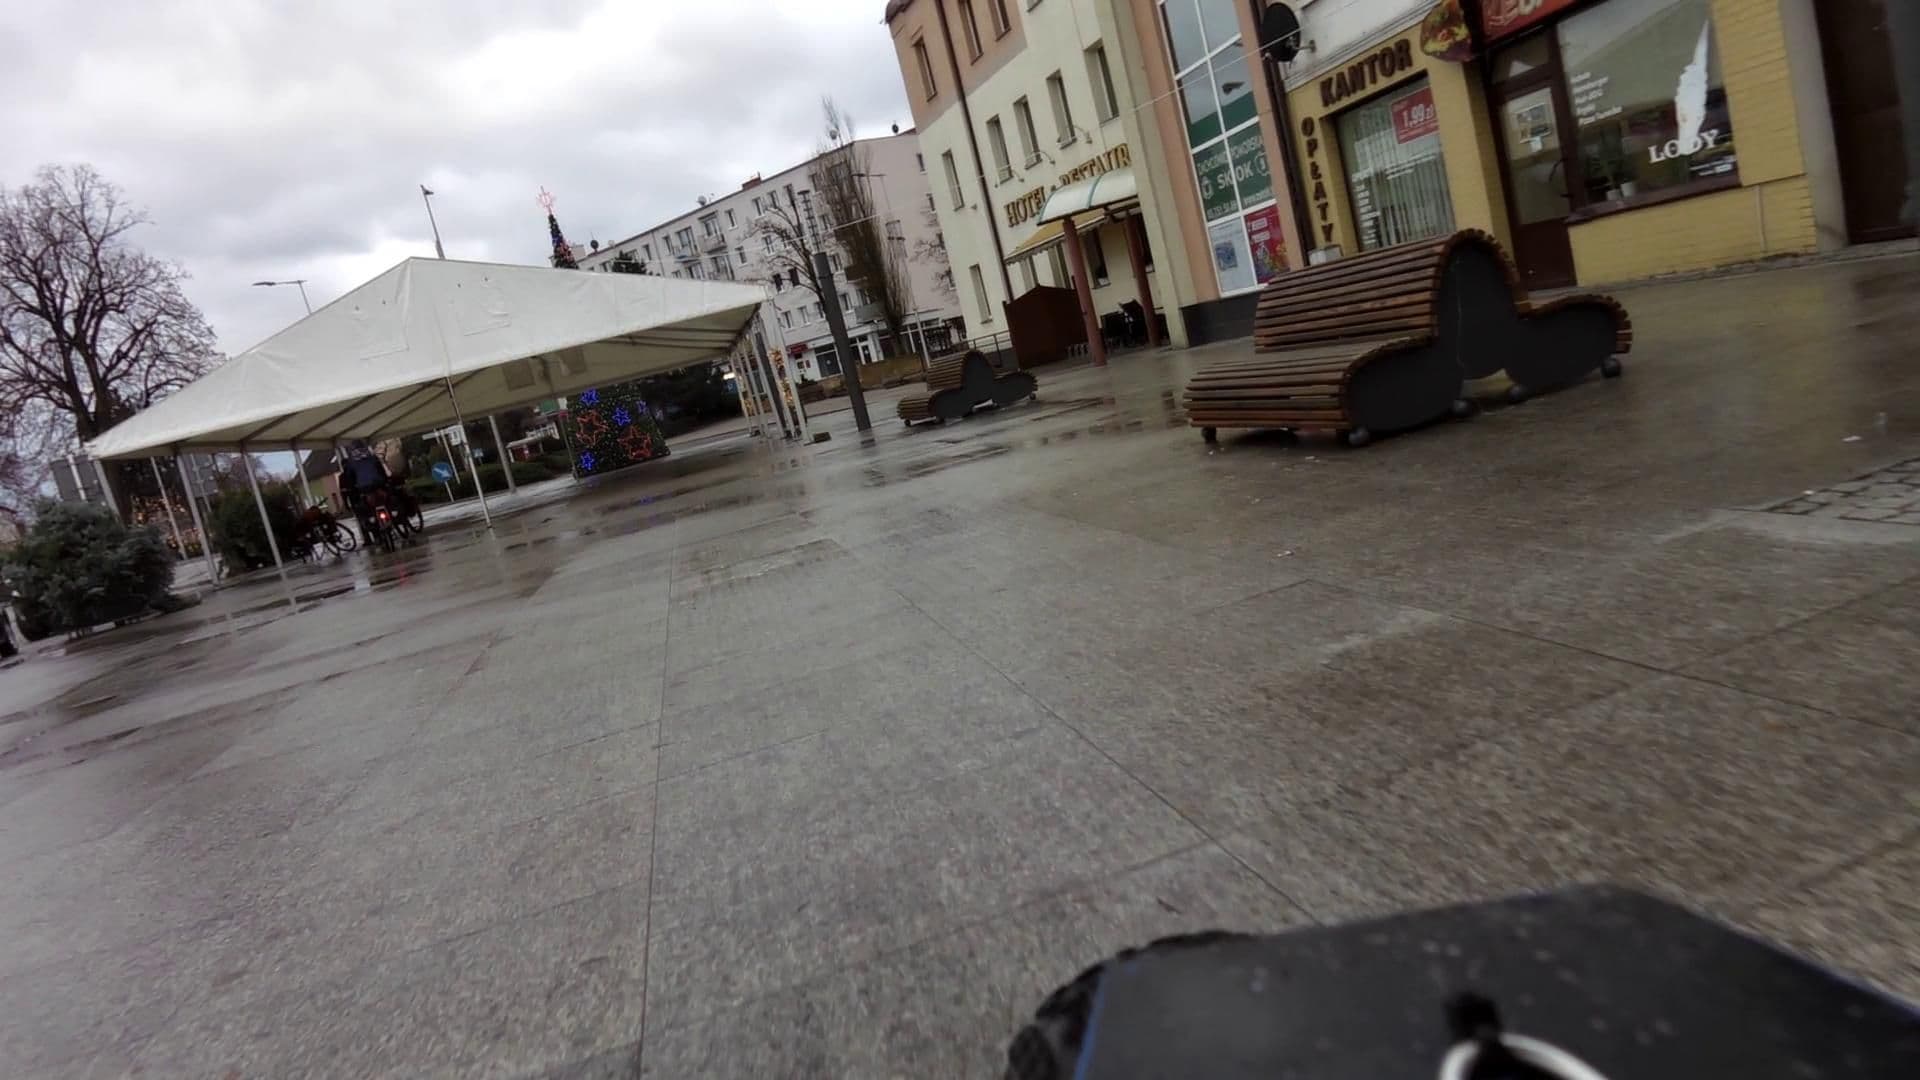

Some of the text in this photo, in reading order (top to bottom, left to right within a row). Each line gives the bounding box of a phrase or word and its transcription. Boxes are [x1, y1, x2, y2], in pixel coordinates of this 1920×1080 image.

[1319, 38, 1414, 107] KANTOR
[1648, 129, 1719, 164] LODY
[1216, 159, 1254, 190] SKOK
[1003, 186, 1047, 228] HOTEL
